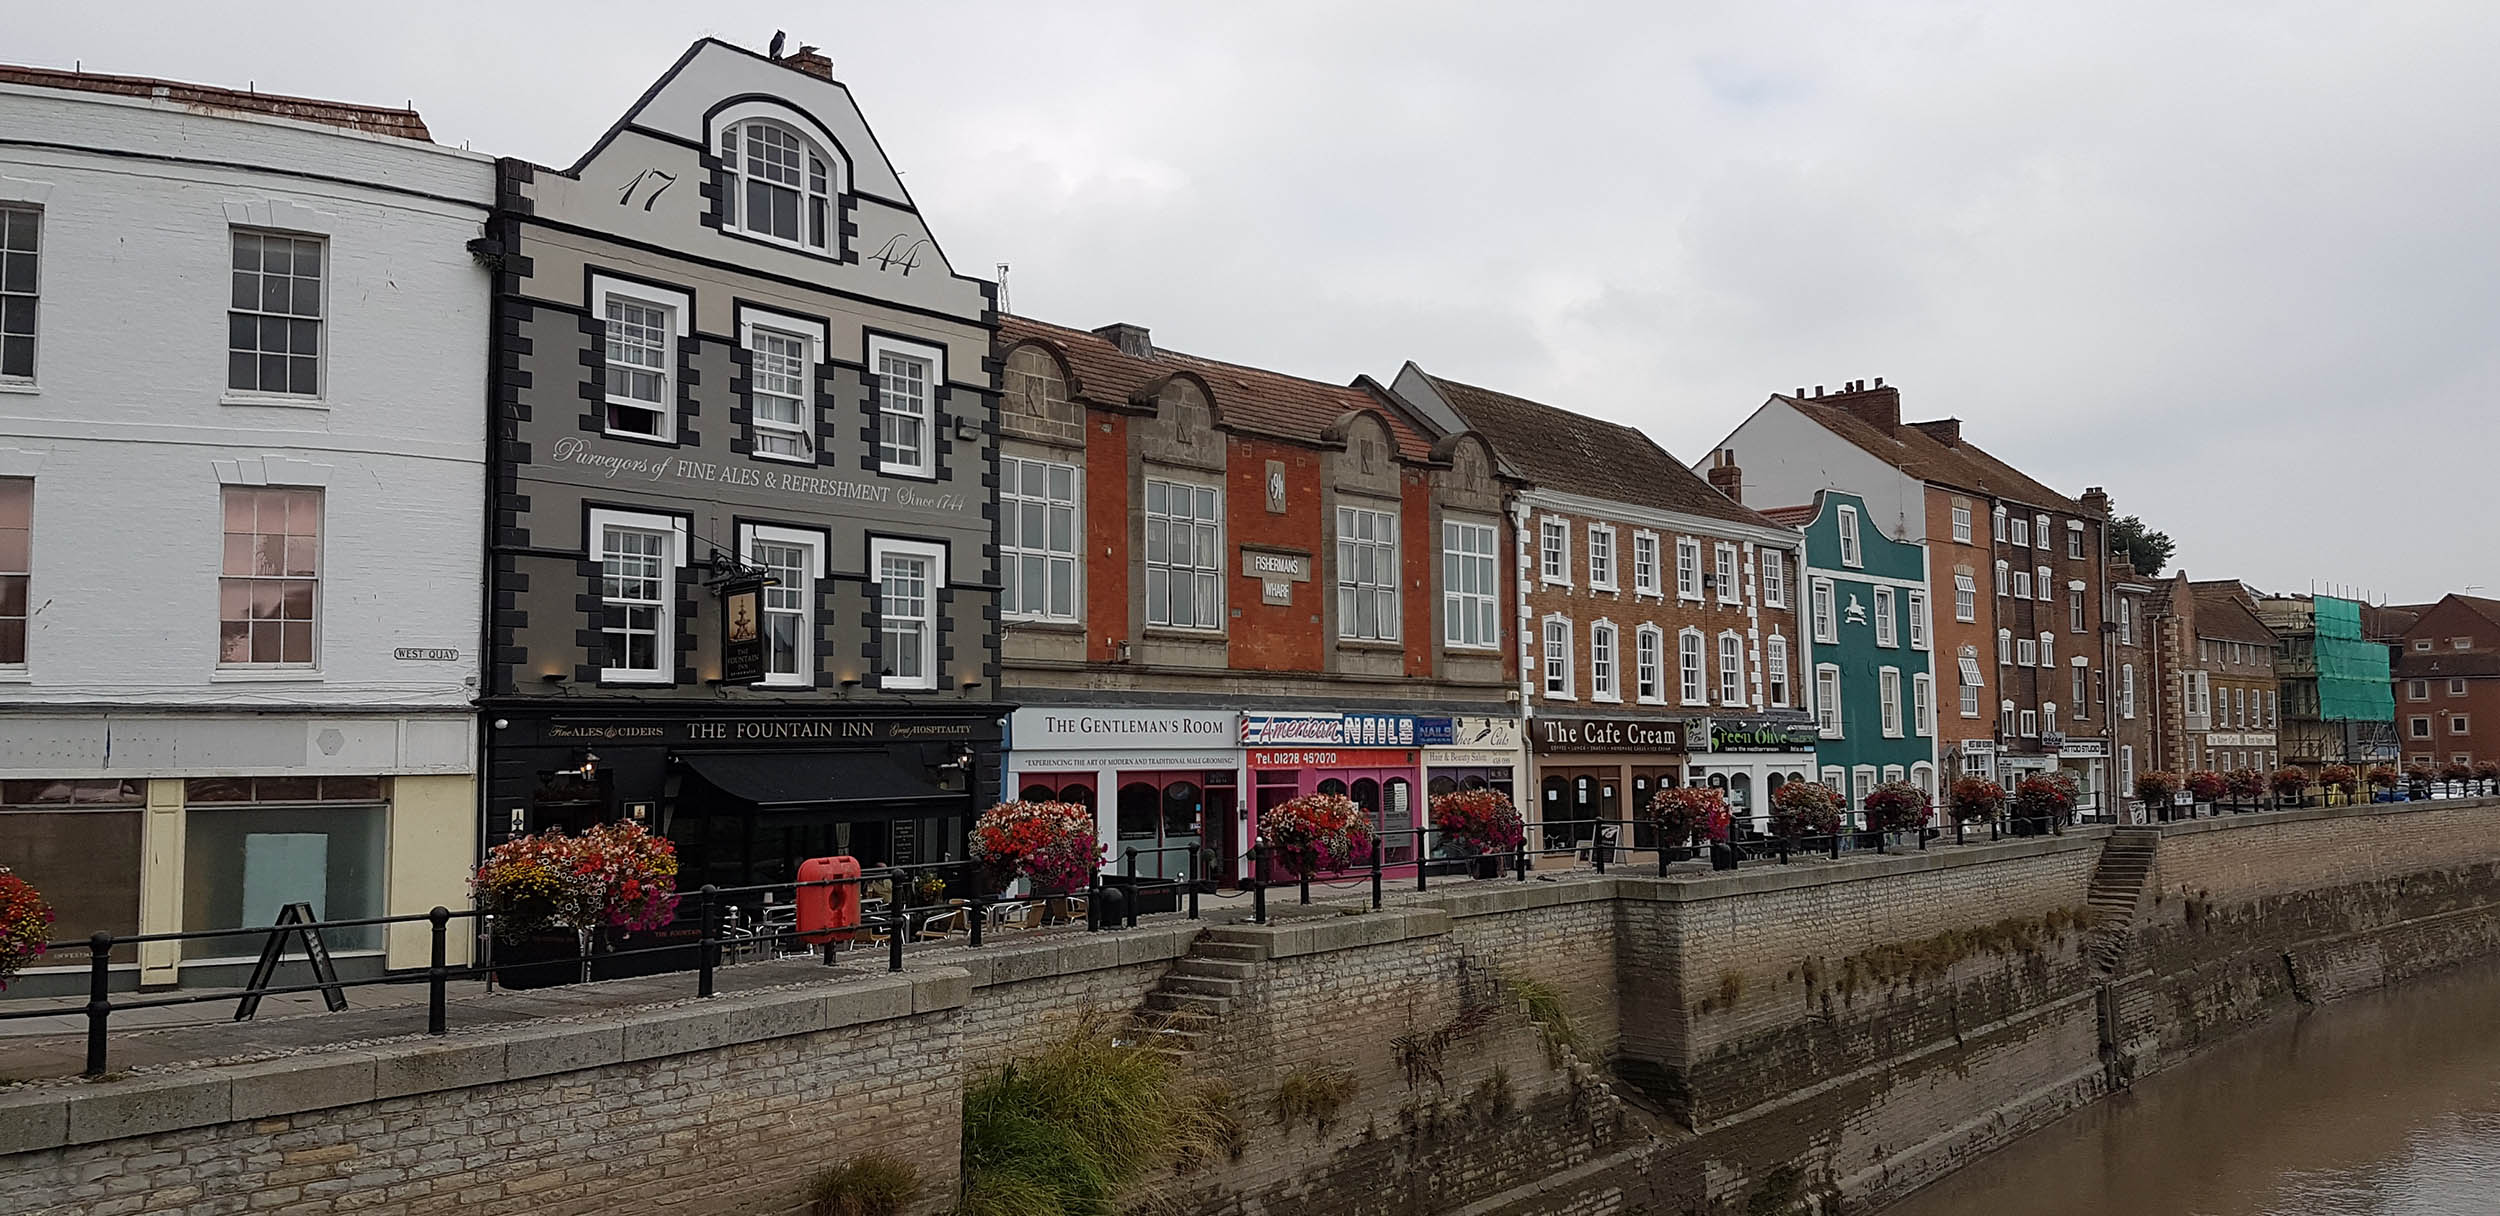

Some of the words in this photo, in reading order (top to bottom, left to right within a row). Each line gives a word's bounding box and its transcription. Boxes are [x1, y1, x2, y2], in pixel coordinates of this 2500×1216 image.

[618, 168, 677, 212] 17
[867, 233, 930, 277] 44
[552, 436, 648, 479] Purveyors
[651, 456, 674, 482] of
[676, 459, 717, 482] FINE
[719, 466, 761, 487] ALES
[764, 471, 778, 489] &
[781, 474, 892, 503] REFRESHMENT
[896, 486, 935, 508] Since
[935, 493, 967, 512] 1744
[1264, 582, 1289, 598] WHARF
[398, 649, 424, 658] WEST
[428, 650, 456, 659] QUAY
[548, 724, 572, 737] Fine
[571, 727, 604, 737] ALES
[618, 727, 664, 737] CIDERS
[686, 723, 727, 739] THE
[736, 722, 833, 739] FOUNTAIN
[841, 721, 875, 737] INN
[913, 725, 972, 734] HOSPITALITY
[1258, 715, 1342, 744] American
[1343, 716, 1414, 744] NAILS
[1420, 726, 1452, 738] NAILS
[1490, 726, 1510, 745] Cuts
[1543, 721, 1577, 743] The
[1584, 722, 1621, 744] Cafe
[1627, 723, 1677, 744] Cream
[1754, 726, 1788, 745] Olive
[2062, 745, 2081, 753] ATTOO
[1086, 758, 1098, 766] ART
[1098, 758, 1107, 766] OF
[1107, 758, 1134, 766] MODERN
[1148, 757, 1186, 765] TRADITIONAL
[1255, 753, 1273, 765] Tel.
[1273, 753, 1300, 765] 01278
[1302, 753, 1337, 764] 457070
[1429, 752, 1443, 761] Hair
[1443, 752, 1450, 761] &
[1450, 752, 1470, 763] Beauty
[1471, 752, 1488, 762] Salon
